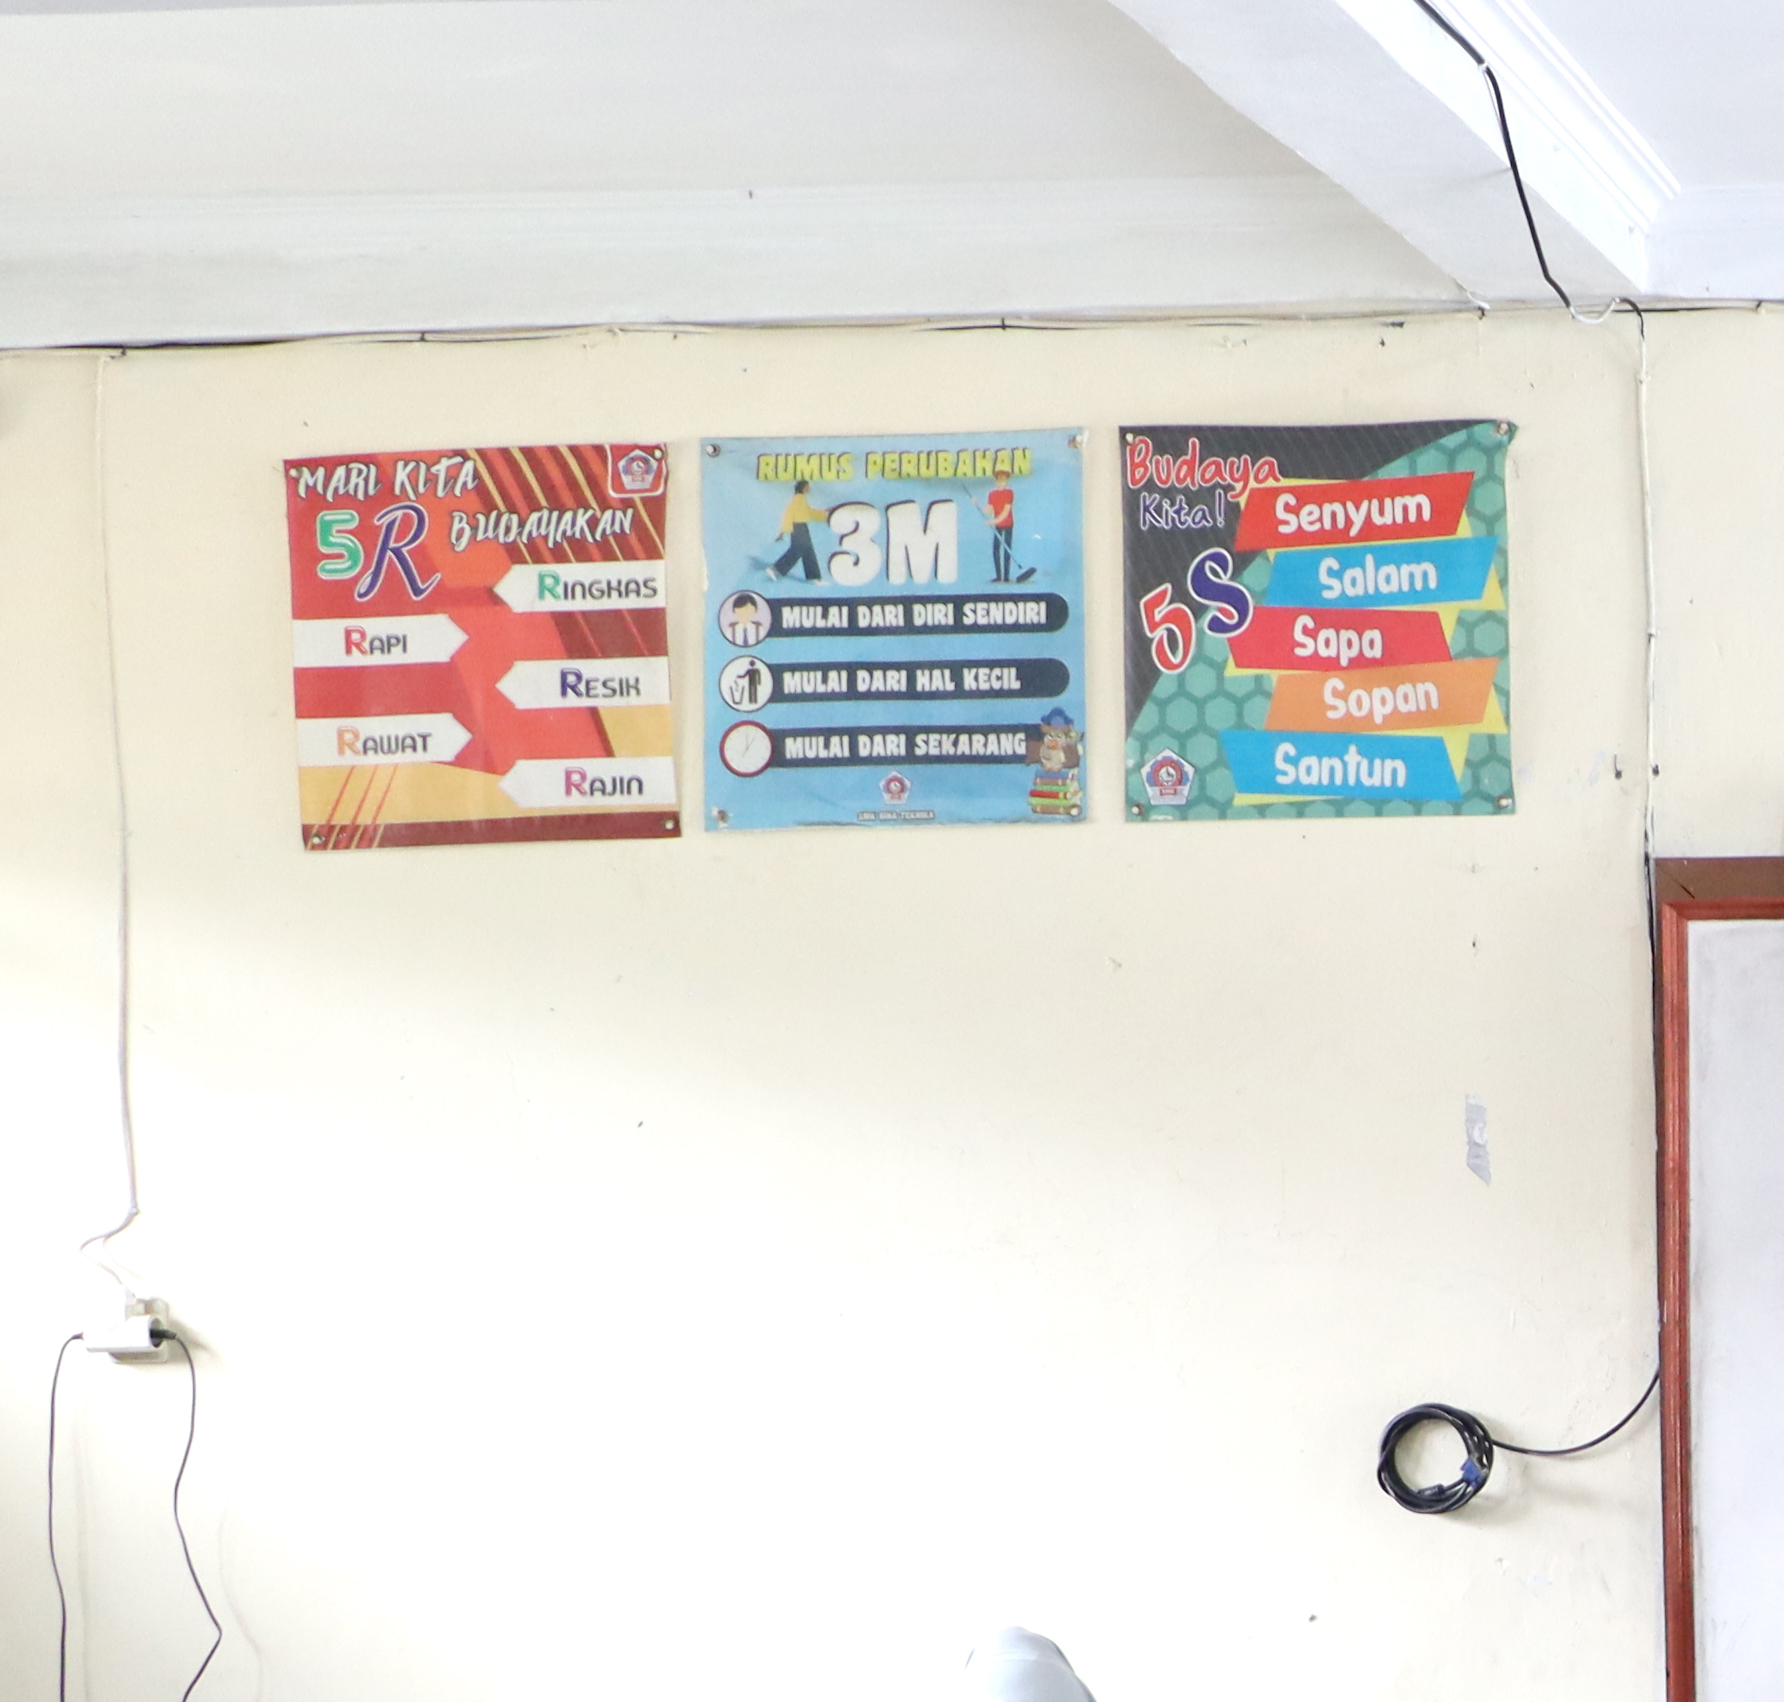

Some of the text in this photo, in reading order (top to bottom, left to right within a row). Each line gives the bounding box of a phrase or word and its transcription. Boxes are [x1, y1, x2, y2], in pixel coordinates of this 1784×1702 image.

[297, 456, 479, 501] MARI KITA
[757, 448, 1032, 482] RUMUS PERUBAHAN
[1126, 437, 1282, 502] Budaya
[450, 508, 634, 552] BUDAYAKAN
[1140, 489, 1226, 530] Kita!
[1275, 491, 1431, 538] Senyum
[827, 499, 958, 586] 3M
[1318, 553, 1438, 600] Salam
[781, 601, 1047, 629] MULAI DARI DIRI SENDIRI
[1293, 614, 1383, 667] Sapa
[783, 667, 1021, 694] MULAI DARI HAL KECIL
[1323, 677, 1440, 725] Sopan
[784, 732, 1027, 759] MULAI DARI SEKARANG
[1274, 741, 1407, 788] Santun
